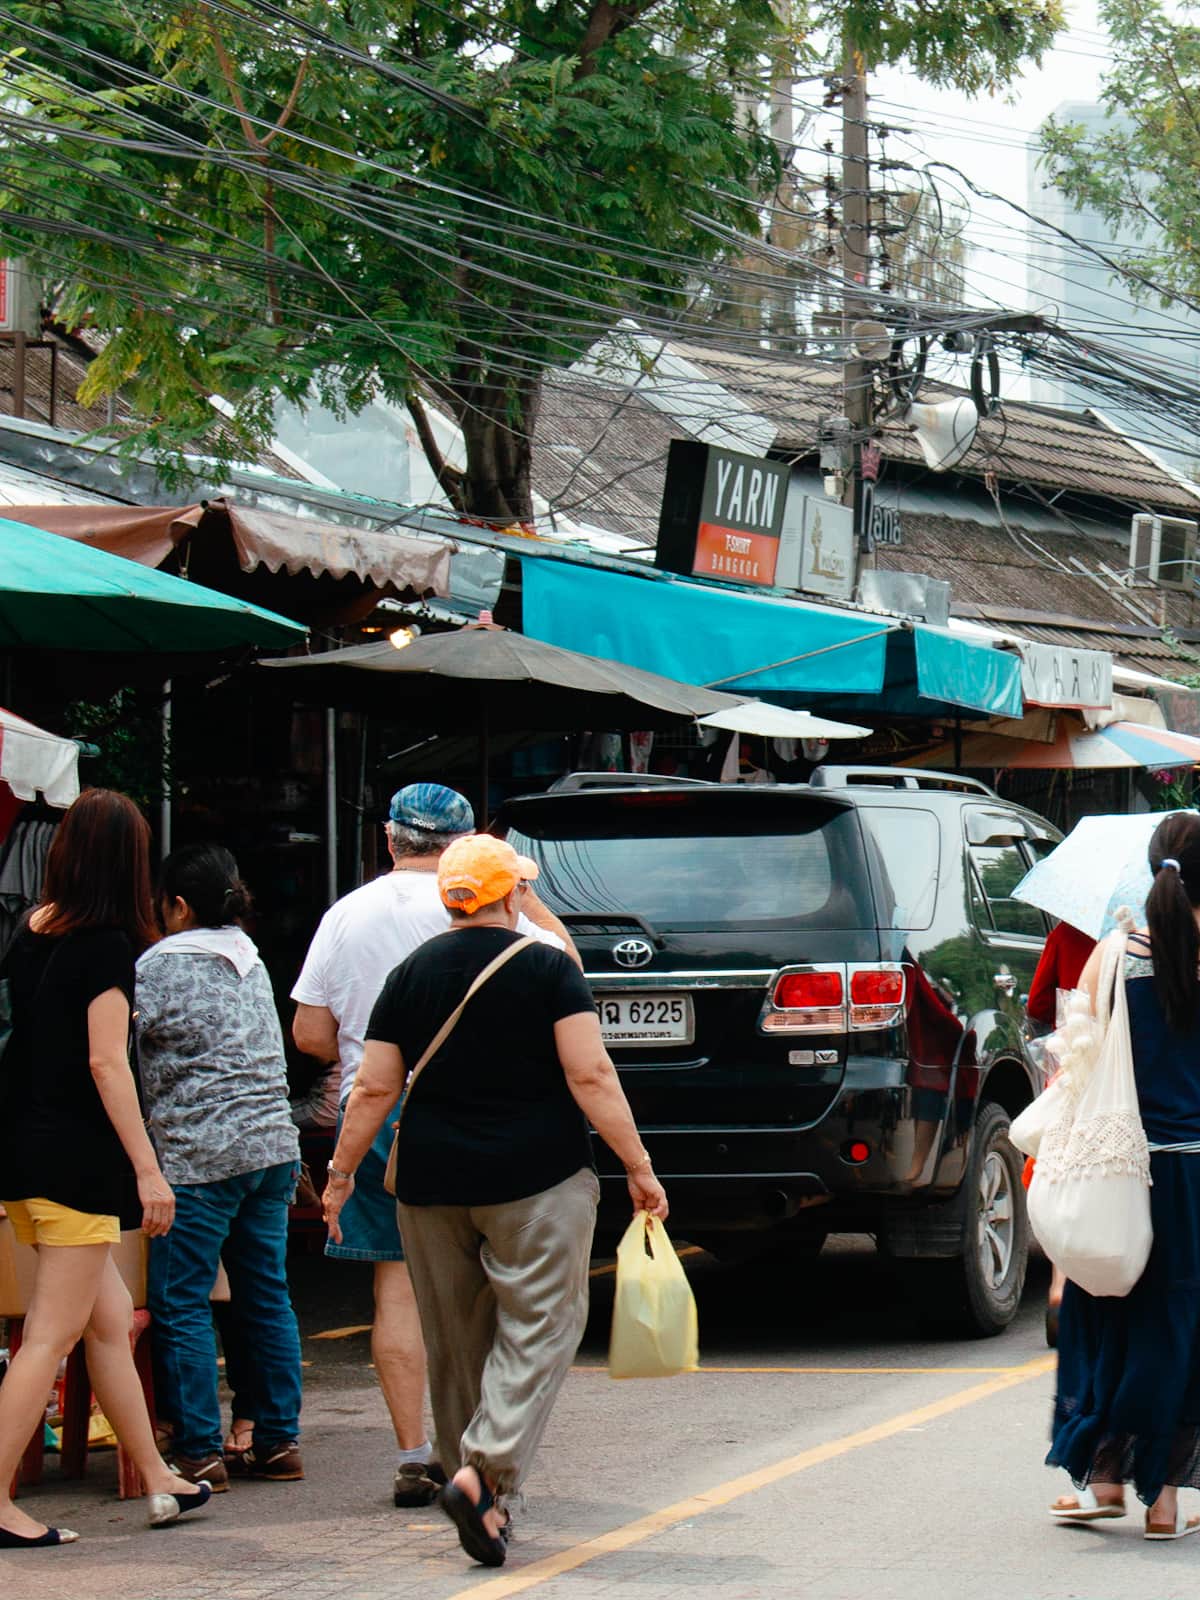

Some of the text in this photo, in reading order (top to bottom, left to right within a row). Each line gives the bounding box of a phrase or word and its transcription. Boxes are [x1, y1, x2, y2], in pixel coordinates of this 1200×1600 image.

[715, 459, 779, 529] YARN
[712, 553, 760, 577] BANGKOK
[629, 1000, 683, 1024] 6225
